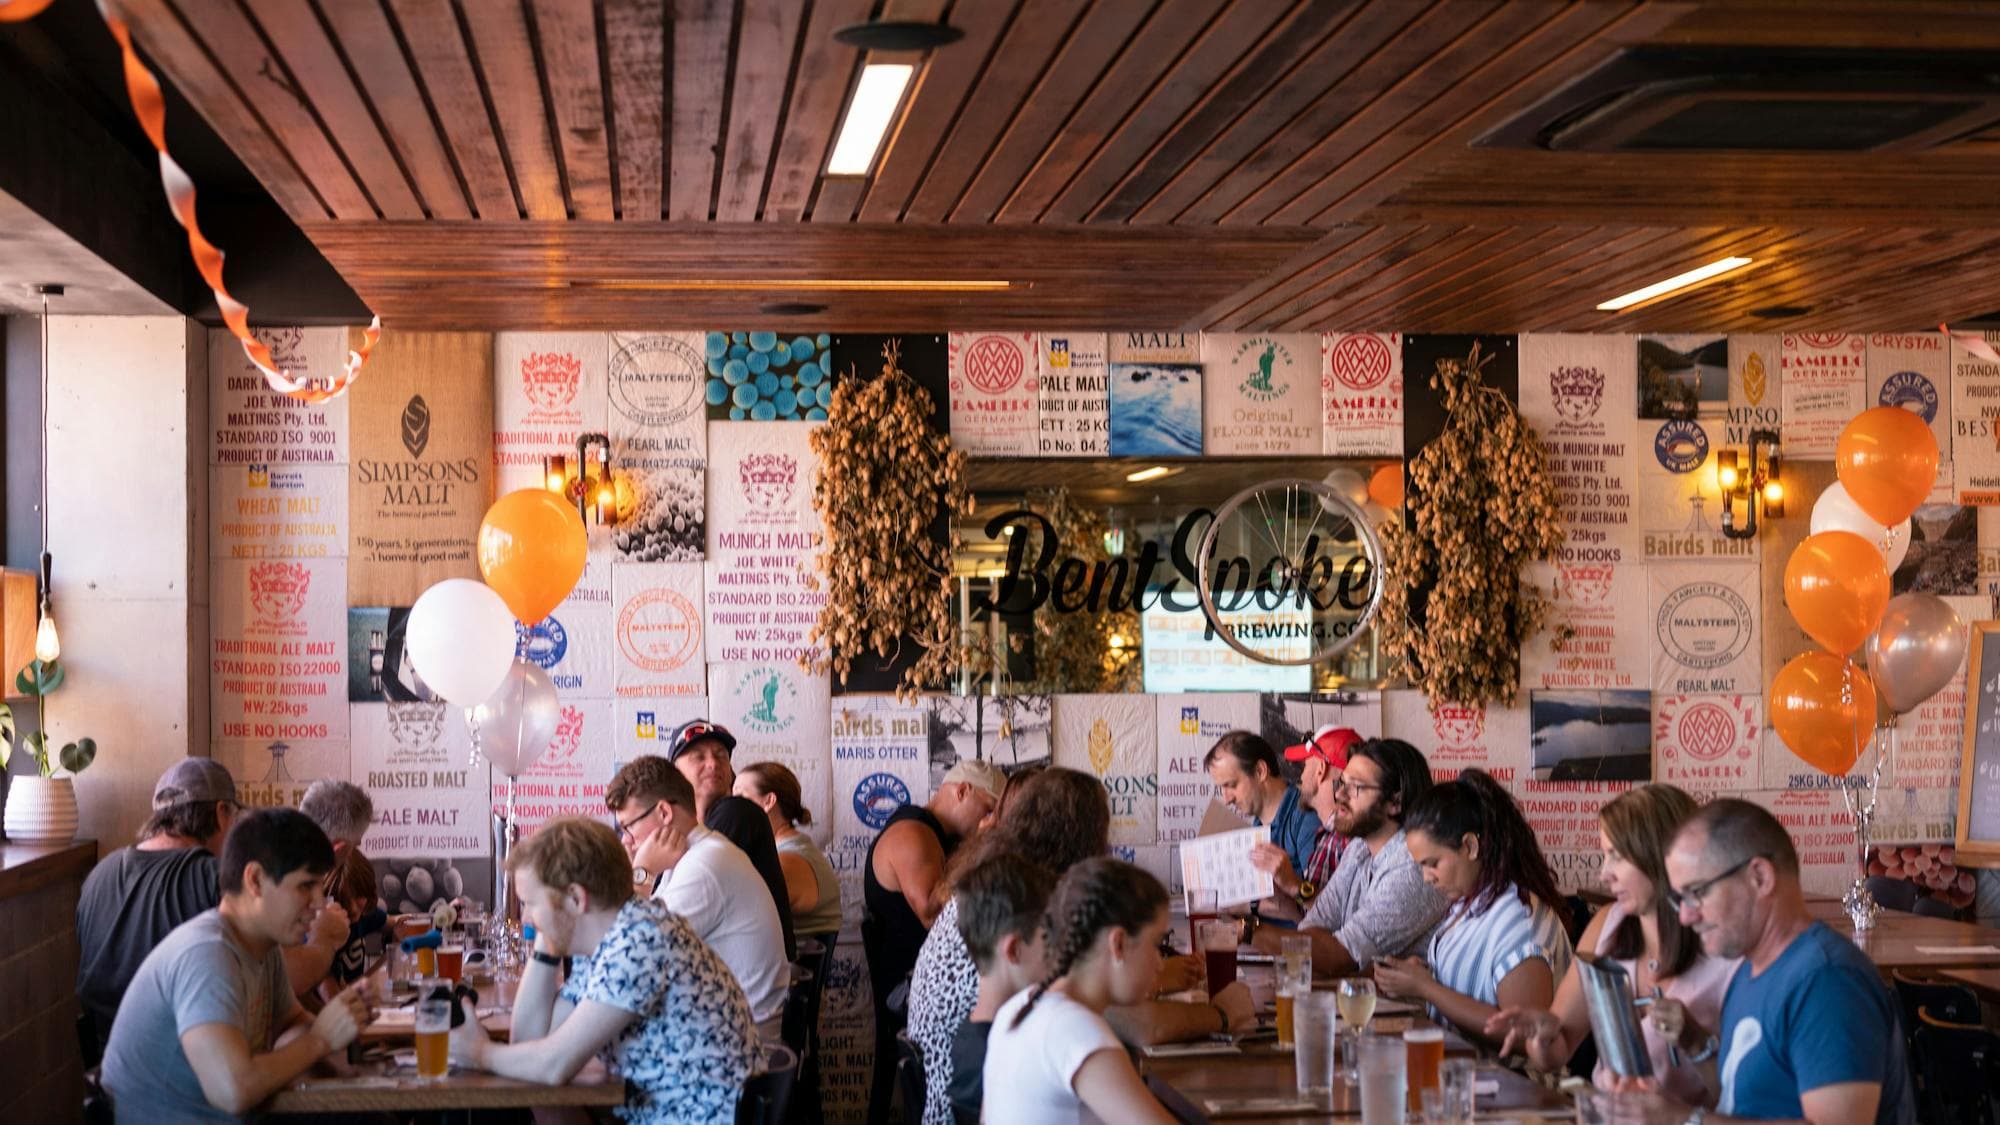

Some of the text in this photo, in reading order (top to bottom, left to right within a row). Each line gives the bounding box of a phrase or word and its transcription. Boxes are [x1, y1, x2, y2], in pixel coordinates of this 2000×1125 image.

[1871, 335, 1943, 351] CRYSTAL
[227, 376, 258, 391] DARK
[624, 373, 692, 383] MALTSTERS
[1040, 375, 1109, 392] PALE MALT
[243, 395, 268, 409] JOE
[1068, 400, 1079, 412] OF
[227, 412, 281, 426] MALTINGS
[1076, 419, 1091, 432] 25
[216, 430, 337, 445] STANDARD ISO 9001
[493, 431, 576, 445] TRADITIONAL ALE
[1213, 427, 1313, 439] FLOOR MALT
[1658, 420, 1705, 448] ASSURED
[628, 437, 692, 451] PEARL MALT
[1563, 442, 1626, 457] MUNICH MALT
[217, 448, 334, 463] PRODUCT OF AUSTRALIA
[358, 457, 479, 484] SIMPSONS
[1547, 460, 1606, 473] JOE WHITE
[383, 483, 455, 505] MALT
[1580, 493, 1630, 508] ISO 9001
[237, 496, 321, 515] WHEAT MALT
[1567, 511, 1628, 524] OF AUSTRALIA
[221, 522, 337, 538] PRODUCT OF AUSTRALIA
[1571, 529, 1607, 544] 25kgs
[356, 536, 411, 548] 150 5
[719, 532, 814, 550] MUNICH MALT
[1644, 533, 1705, 557] Bairds
[231, 543, 327, 559] NETT KGS
[378, 551, 470, 564] home of good malt
[1577, 548, 1621, 561] HOOKS
[734, 555, 797, 569] JOE WHITE
[718, 572, 770, 585] MALTINGS
[708, 591, 796, 606] STANDARD ISO
[712, 611, 771, 625] PRODUCT OF
[1674, 618, 1737, 628] MALTSTERS
[765, 629, 803, 644] 25kgs
[214, 638, 336, 656] TRADITIONAL ALE MALT
[1585, 640, 1612, 654] MALT
[722, 649, 771, 662] USE NO
[213, 660, 341, 677] STANDARD ISO 22000
[1581, 657, 1617, 671] WHITE
[1541, 671, 1591, 687] MALTINGS
[1676, 678, 1736, 693] PEARL MALT
[223, 680, 327, 696] PRODUCT OF AUSTRALIA
[616, 685, 643, 697] MARIS
[645, 683, 676, 697] OTTER
[1919, 707, 1938, 720] ALE
[223, 722, 328, 738] USE NO HOOKS
[1915, 724, 1934, 737] JOE
[1900, 739, 1948, 752] MALTINGS
[836, 746, 918, 761] MARIS OTTER
[1169, 757, 1199, 774] ALE
[368, 770, 468, 789] ROASTED MALT
[1489, 767, 1516, 781] MALT
[1525, 779, 1634, 794] TRADITIONAL ALE MALT
[1788, 774, 1831, 789] 25KG UK
[1893, 776, 1947, 790] PRODUCT OF
[558, 783, 579, 797] ALE
[857, 775, 907, 804] ASSURED
[1199, 784, 1211, 797] OF
[417, 808, 459, 827] MALT
[1163, 805, 1197, 818] NETT
[1567, 819, 1577, 832] OF
[1808, 815, 1826, 827] ALE
[365, 835, 480, 851] PRODUCT OF AUSTRALIA
[1543, 833, 1564, 846] NW
[1804, 833, 1822, 847] ISO
[1825, 831, 1855, 846] 22000
[1803, 851, 1846, 865] AUSTRALIA
[829, 1073, 866, 1086] WHITE
